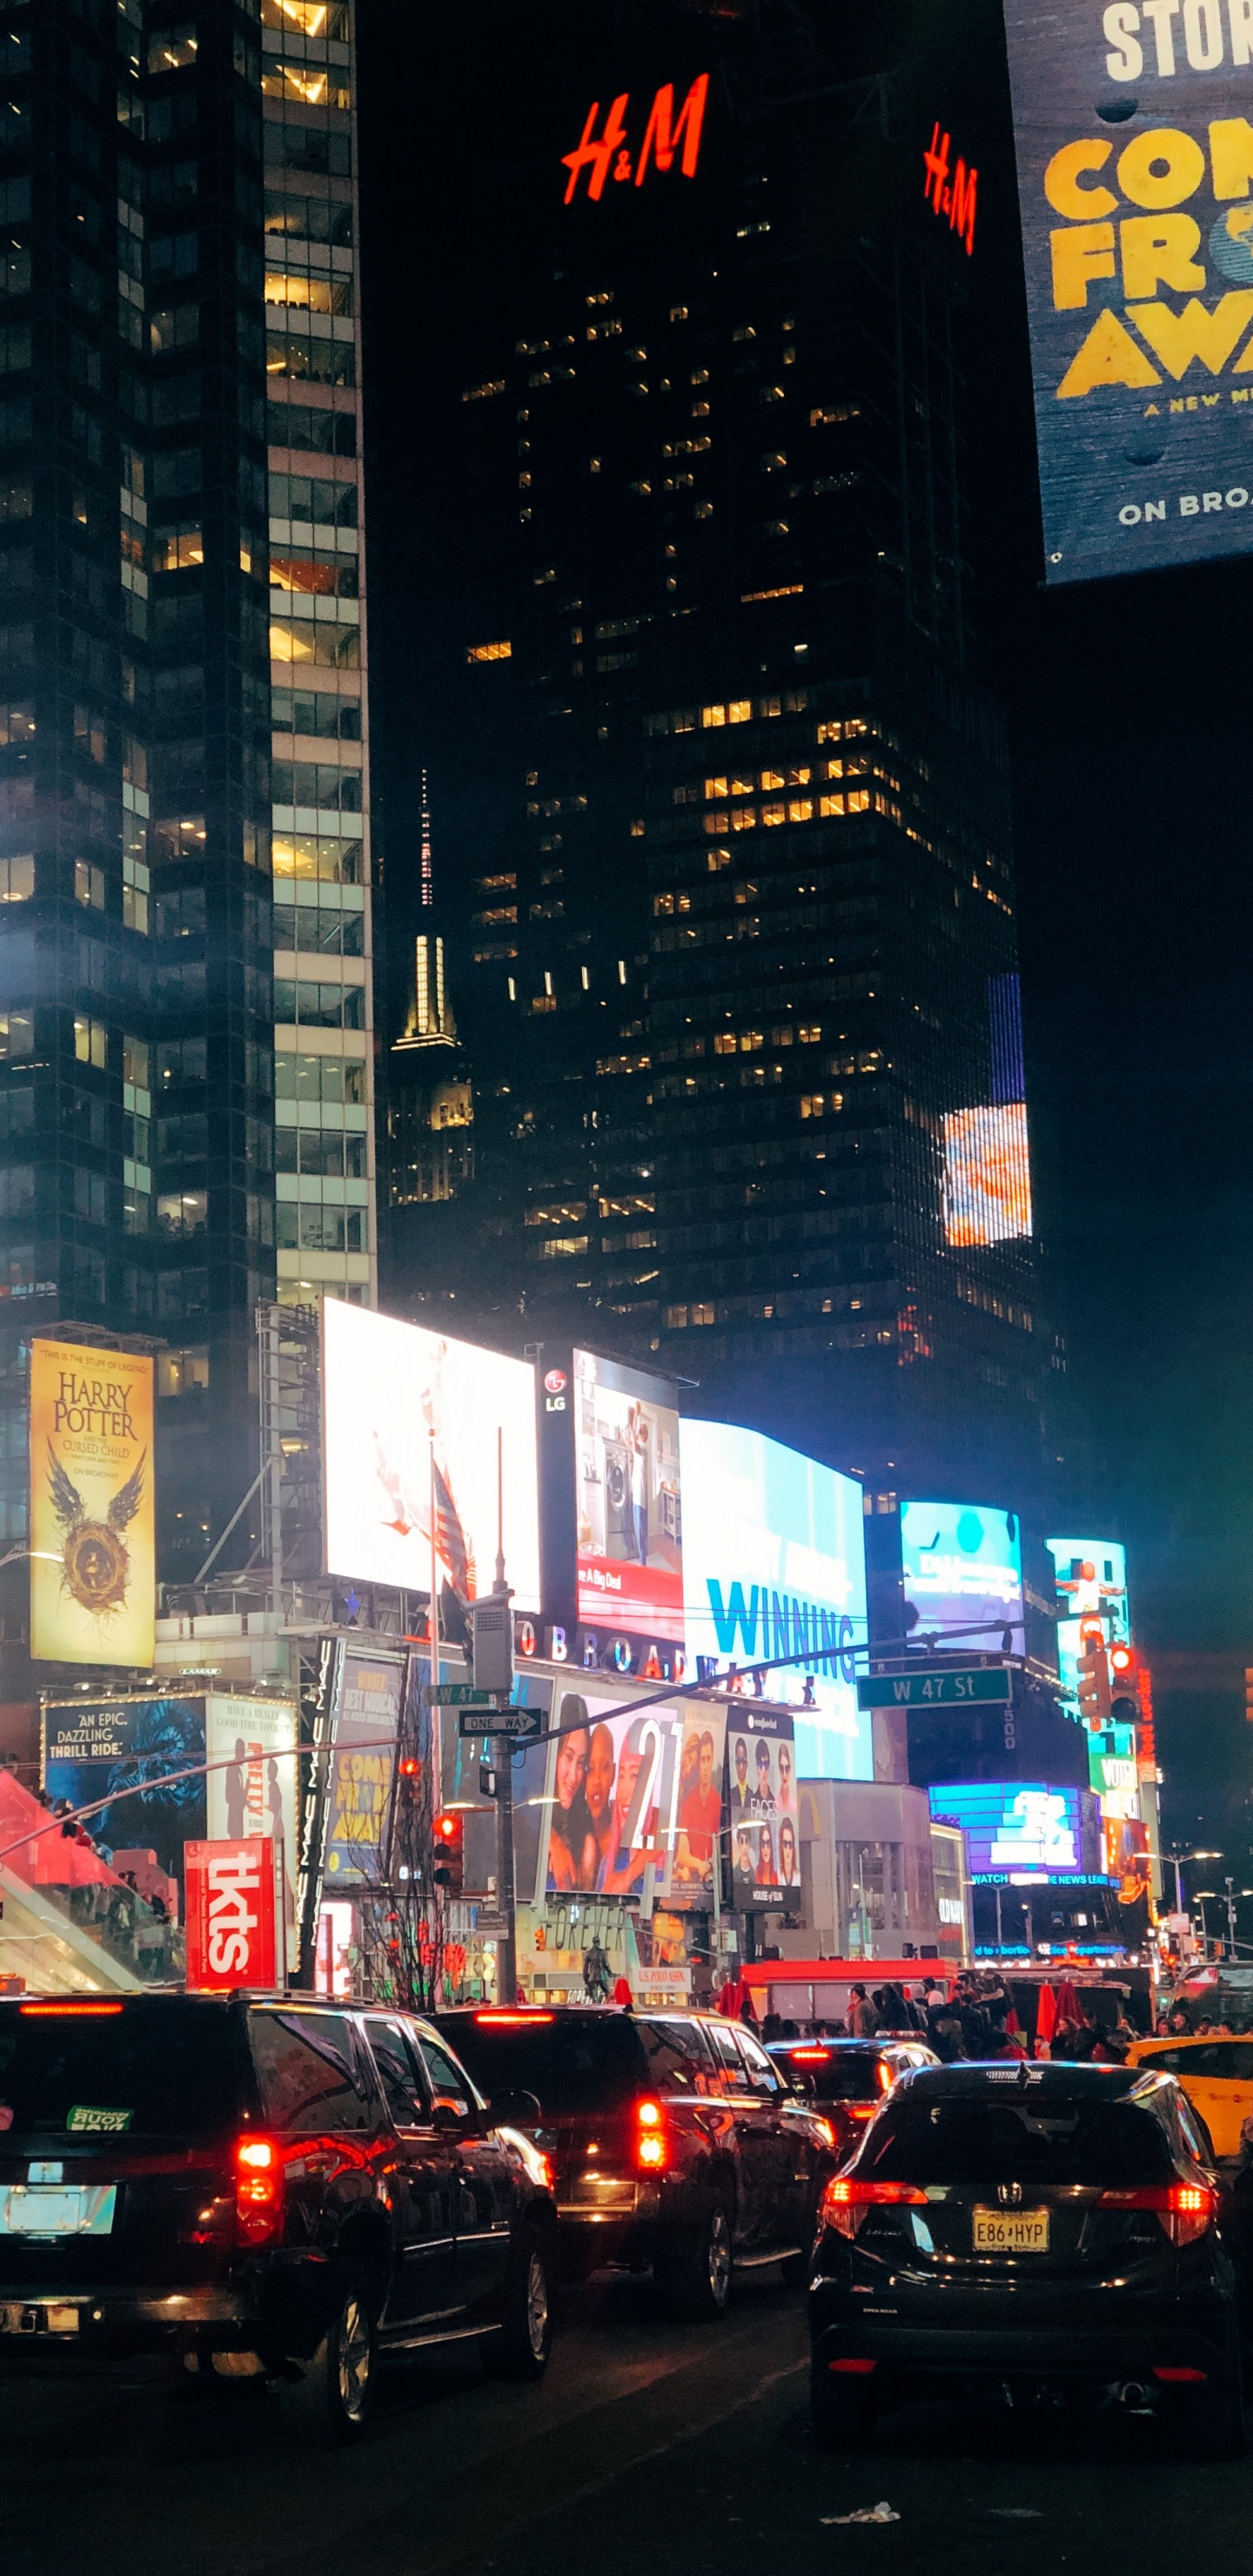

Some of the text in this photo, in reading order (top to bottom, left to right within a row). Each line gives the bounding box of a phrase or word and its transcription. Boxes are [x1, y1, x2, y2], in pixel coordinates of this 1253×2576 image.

[560, 72, 710, 205] H&M
[924, 121, 977, 257] H&M
[1055, 288, 1253, 399] AW
[1143, 388, 1253, 418] A NEW M
[1119, 487, 1253, 526] ON BRO
[70, 1354, 84, 1364] THE
[85, 1357, 106, 1367] STUFF
[58, 1371, 133, 1412] HARRY
[546, 1396, 566, 1412] LG
[53, 1399, 138, 1441] POTTER
[63, 1439, 130, 1459] CURSED CHILD
[84, 1469, 119, 1479] BROADWAY
[706, 1579, 856, 1686] WINNING
[439, 1686, 473, 1703] W 47
[893, 1675, 975, 1701] W 47 St
[217, 1717, 238, 1729] GOOD
[240, 1719, 257, 1731] TIME
[227, 1705, 278, 1721] HAVE A REALLY
[471, 1717, 529, 1729] ONE WAY
[57, 1727, 113, 1744] DAZZLING
[50, 1744, 88, 1759] THRILL
[338, 1754, 391, 1783] COME
[628, 1718, 684, 1851] 21
[750, 1797, 780, 1821] FACES
[971, 1874, 1008, 1884] WATCH
[1059, 1875, 1087, 1885] NEWS
[753, 1890, 768, 1901] HOUSE
[773, 1891, 783, 1902] SUN
[208, 1851, 260, 1974] tkts
[651, 1970, 667, 1982] POLO
